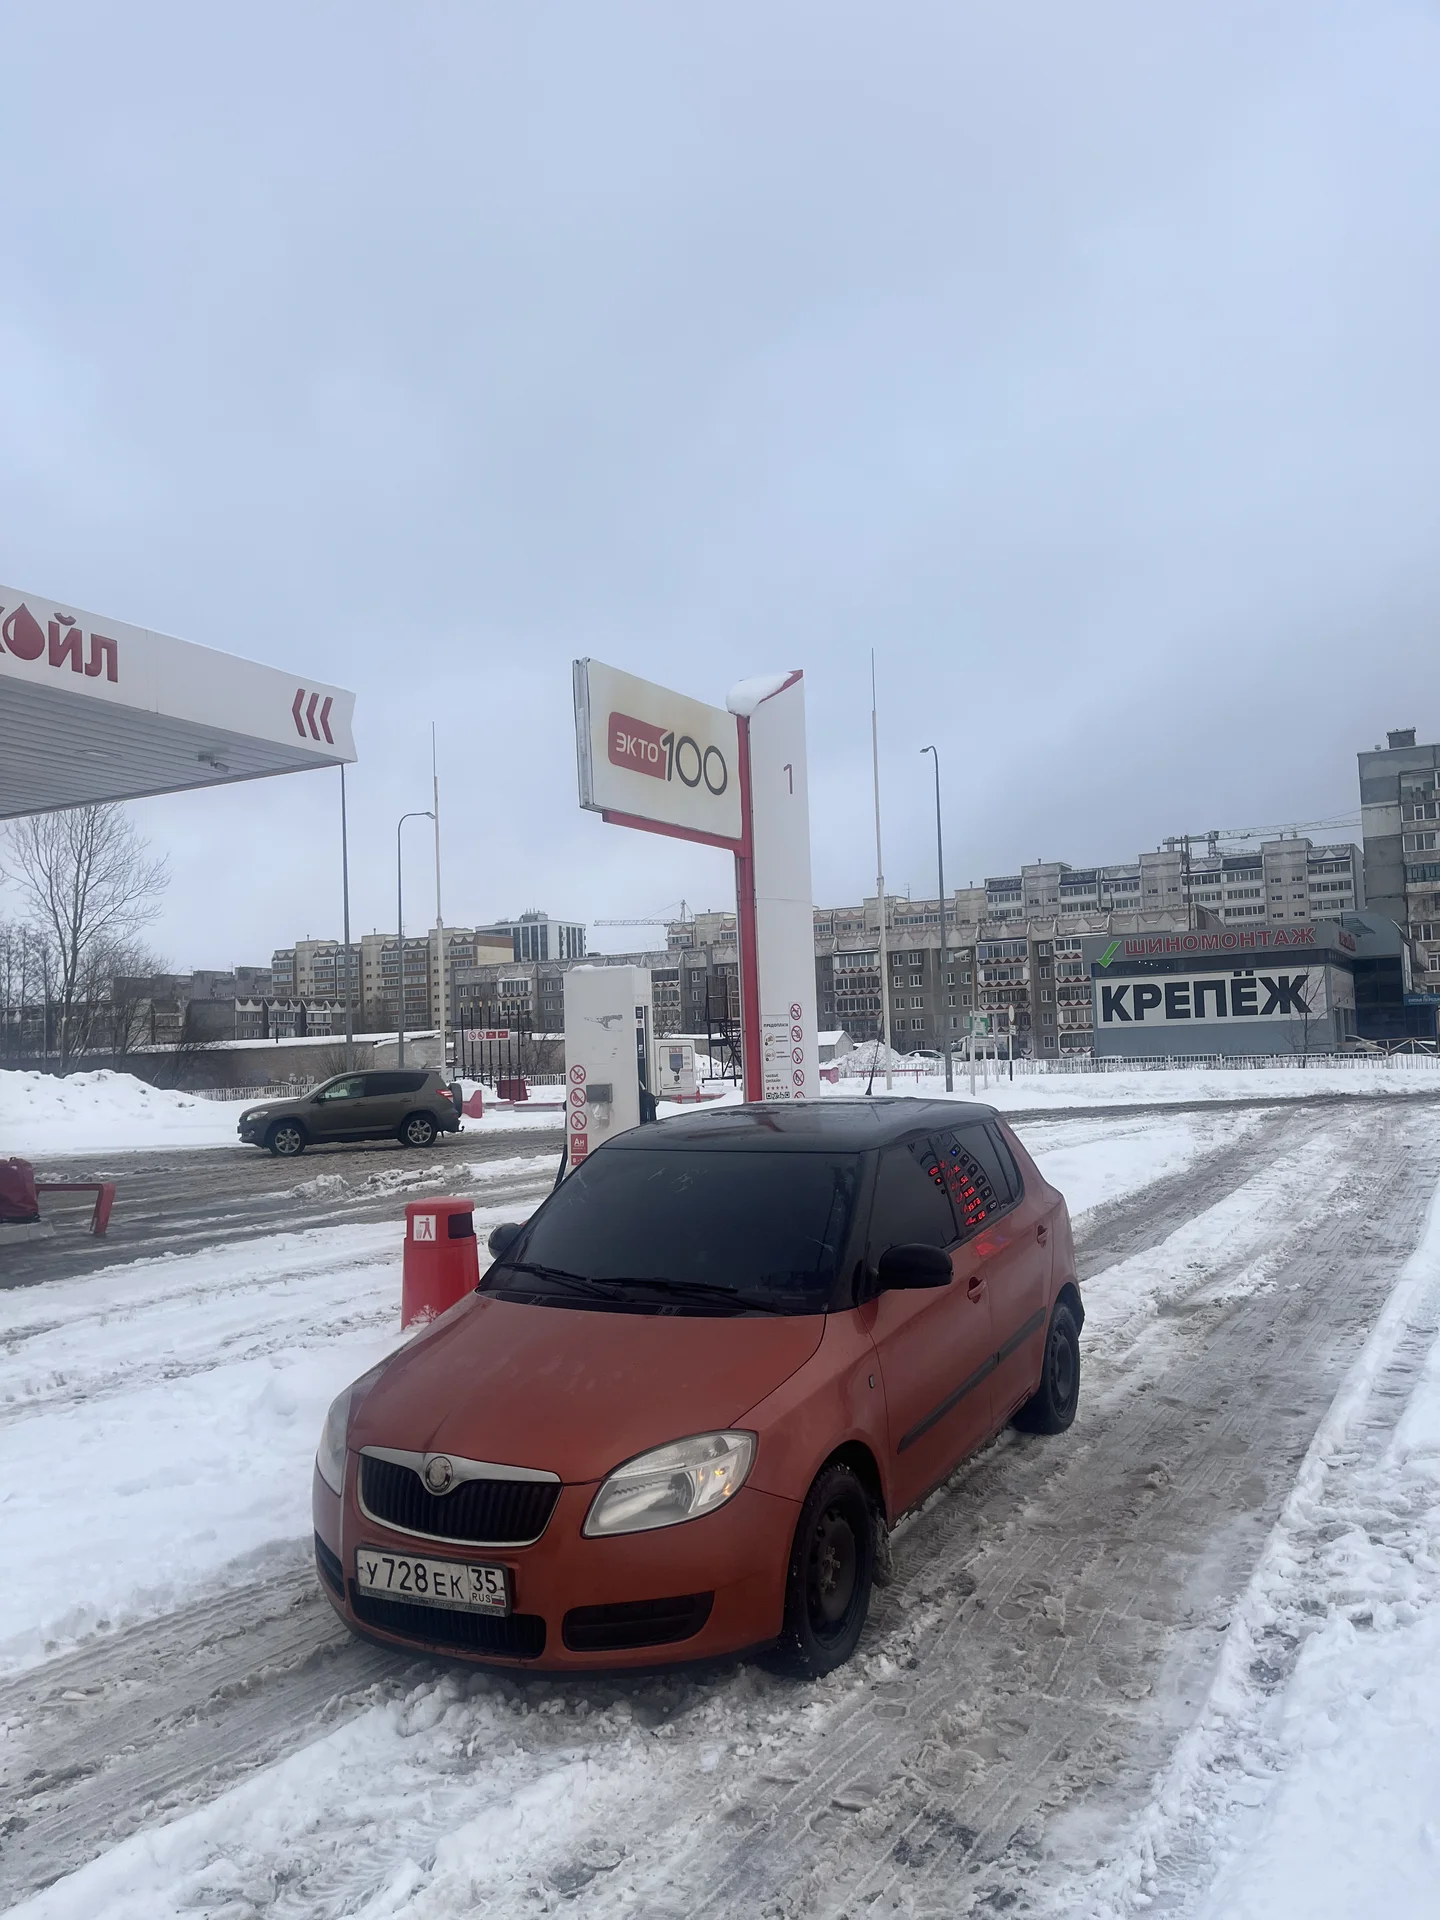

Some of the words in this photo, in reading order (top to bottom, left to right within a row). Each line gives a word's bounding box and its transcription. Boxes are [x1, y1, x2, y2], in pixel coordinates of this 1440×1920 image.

[0, 602, 119, 684] ОЙЛ
[615, 731, 659, 763] ЭКТО
[661, 731, 728, 796] 100
[783, 763, 794, 795] 1
[1124, 926, 1316, 956] ШИНОМОНТАЖ
[1101, 970, 1313, 1023] КРЕПЁЖ
[366, 1557, 465, 1600] У728ЕК
[471, 1568, 498, 1595] 35
[472, 1592, 491, 1604] RUS
